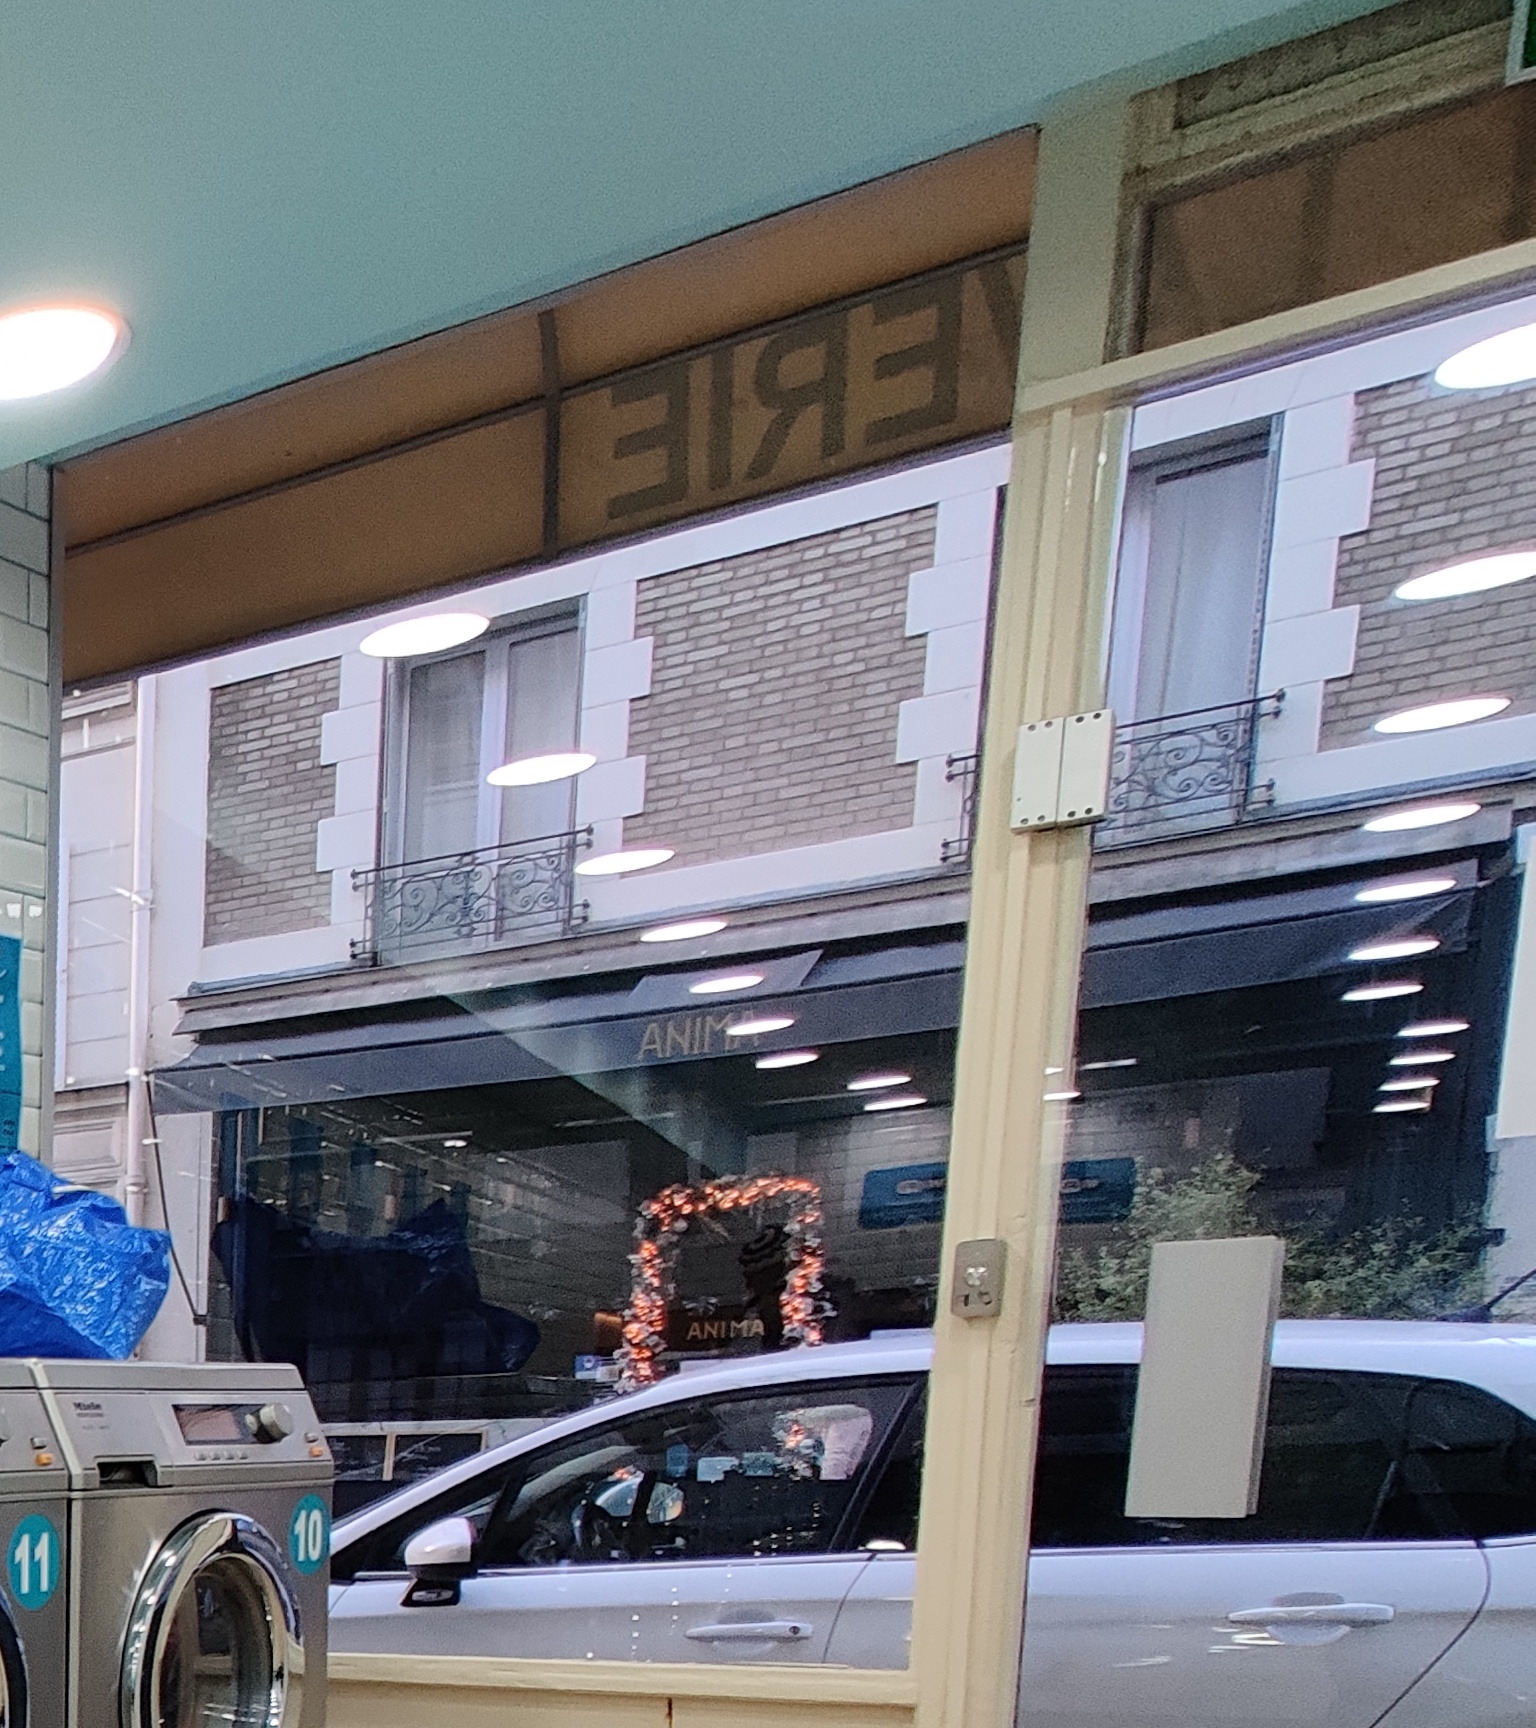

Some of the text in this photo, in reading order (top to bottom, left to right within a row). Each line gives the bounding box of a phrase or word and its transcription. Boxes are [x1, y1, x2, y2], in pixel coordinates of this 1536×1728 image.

[686, 1318, 765, 1340] ANIMA
[293, 1508, 324, 1563] 10
[14, 1532, 50, 1595] 11
